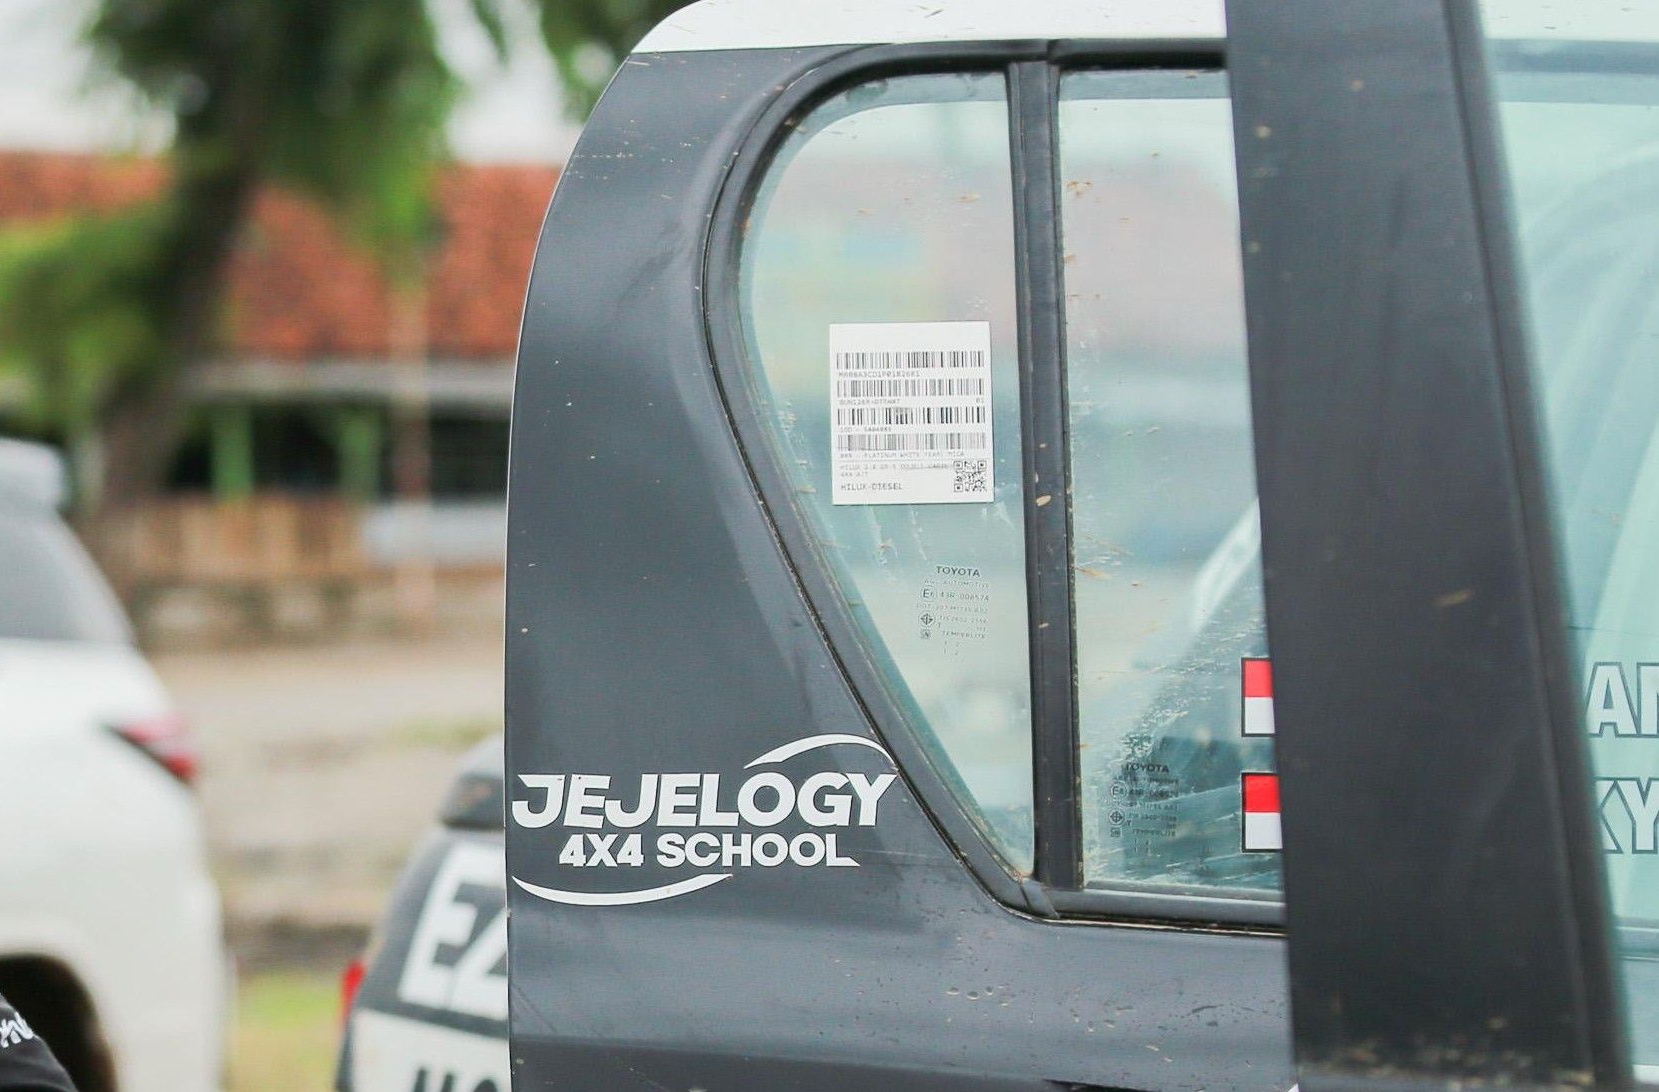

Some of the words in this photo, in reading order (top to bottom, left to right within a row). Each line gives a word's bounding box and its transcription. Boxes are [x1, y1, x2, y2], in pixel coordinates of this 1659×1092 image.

[936, 565, 981, 577] TOYOTA
[1125, 762, 1170, 773] TOYOTA
[511, 771, 898, 829] JEJELOGY
[558, 833, 645, 867] 4X4
[656, 832, 861, 868] SCHOOL
